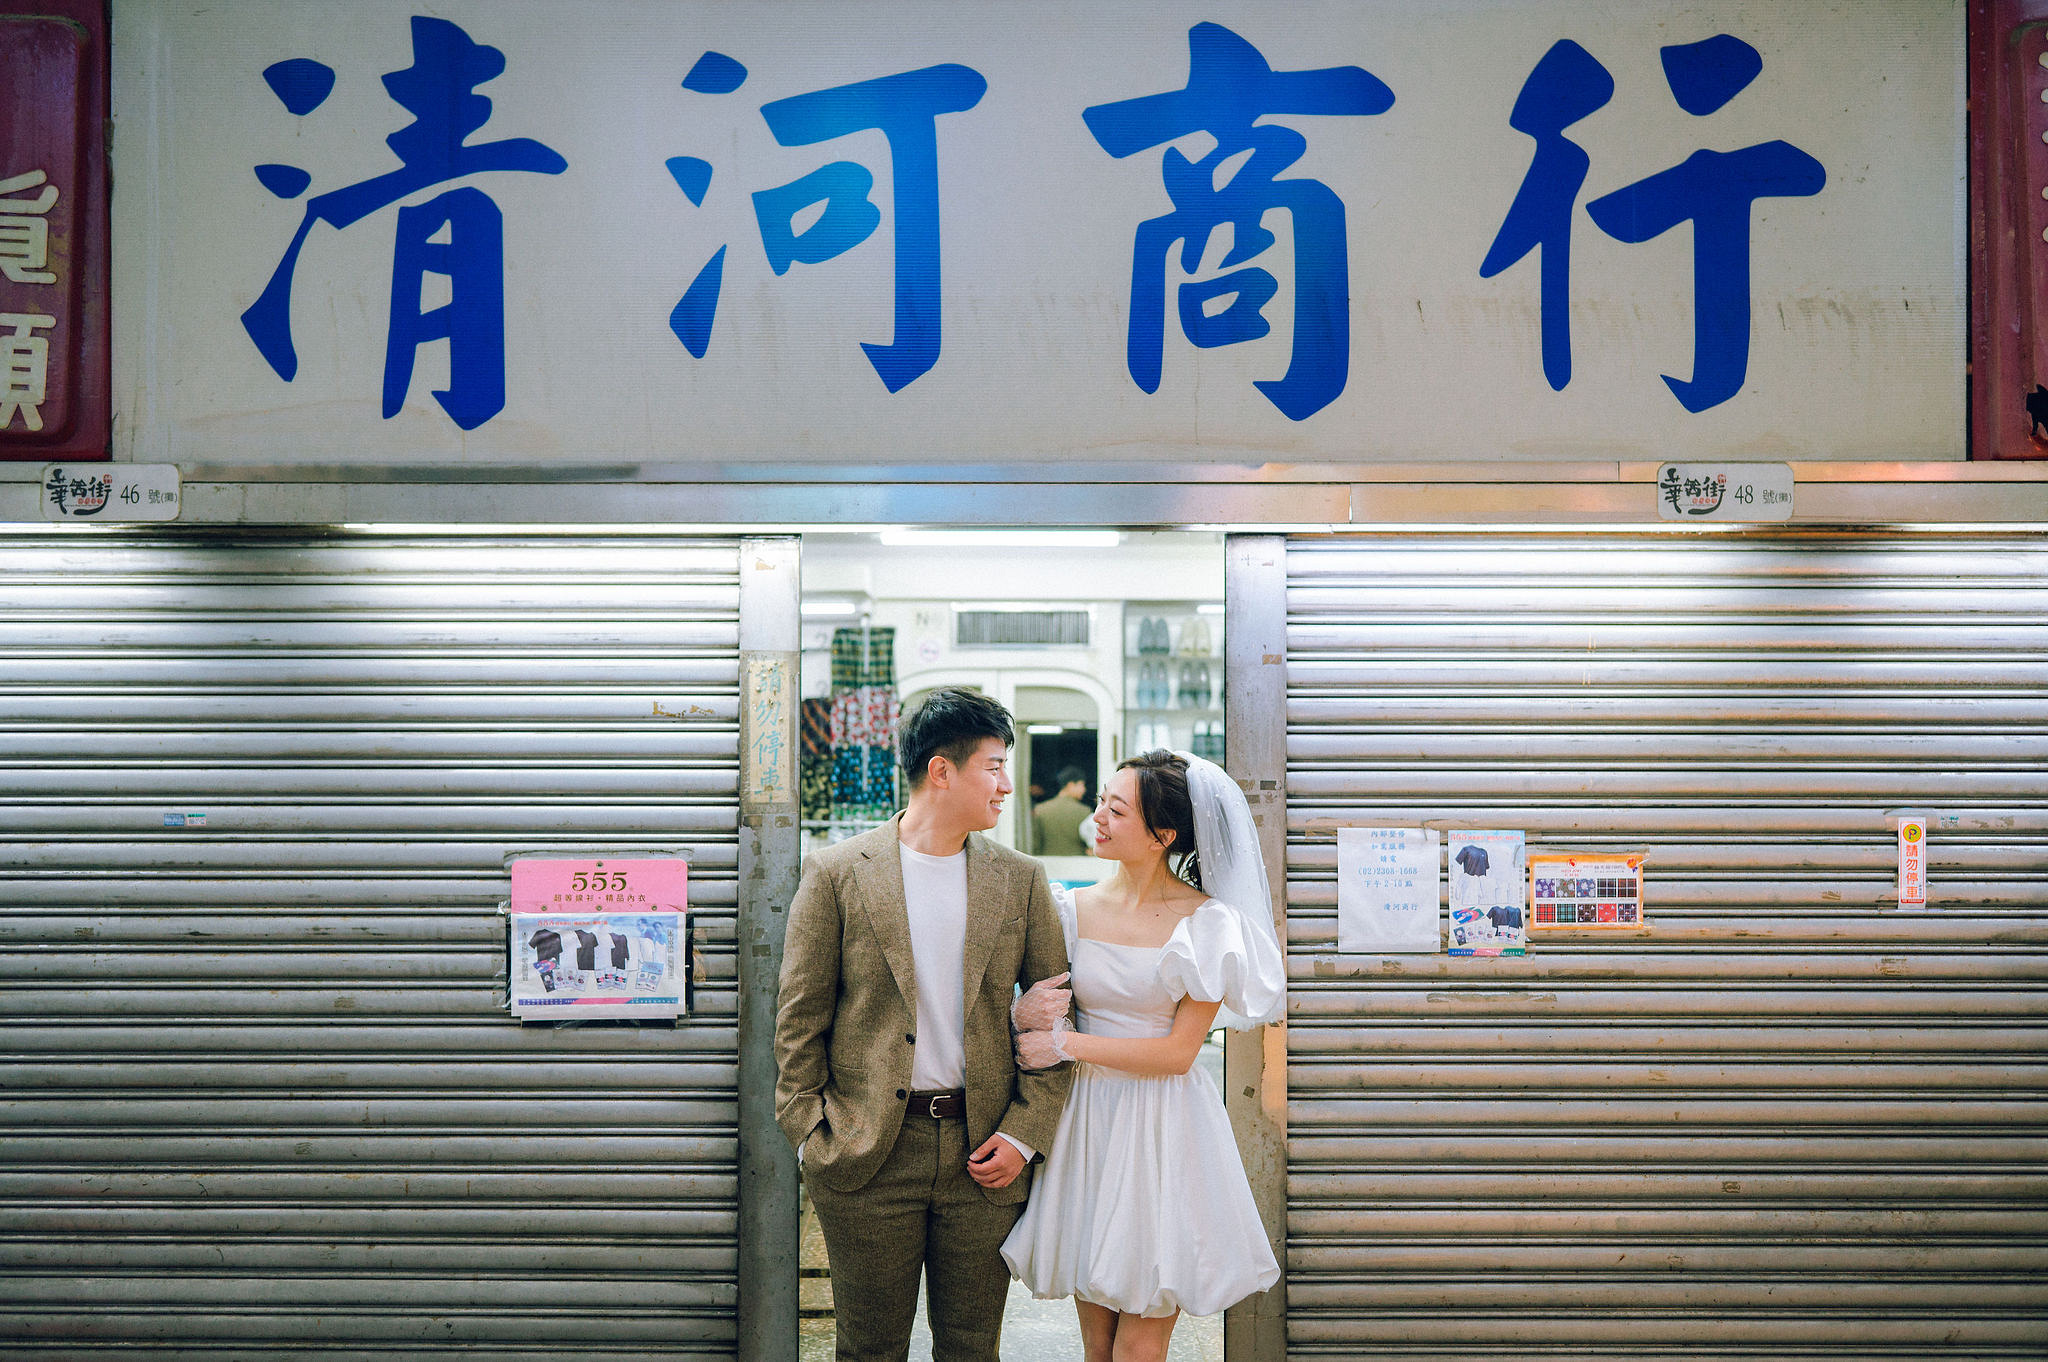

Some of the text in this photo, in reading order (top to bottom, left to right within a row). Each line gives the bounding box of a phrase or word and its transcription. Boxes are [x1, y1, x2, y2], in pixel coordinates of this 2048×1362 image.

[240, 15, 1826, 430] 清河商行
[120, 484, 140, 504] 46
[1735, 485, 1754, 504] 48
[752, 664, 785, 802] 請勿停車
[572, 872, 627, 891] 555
[1906, 845, 1918, 898] 請勿停車
